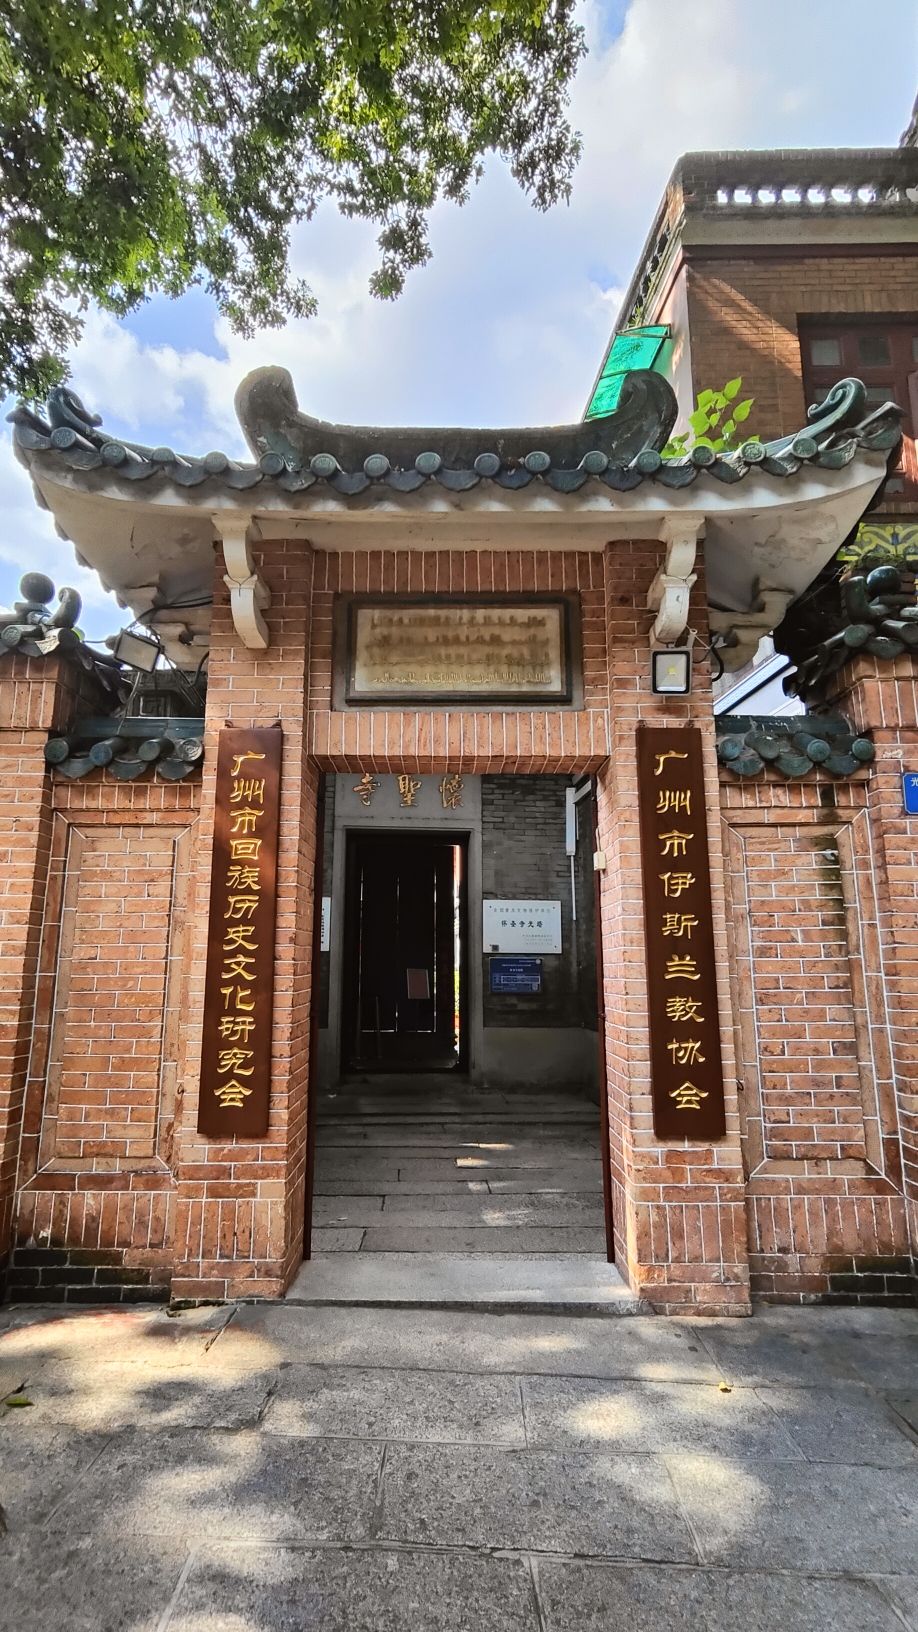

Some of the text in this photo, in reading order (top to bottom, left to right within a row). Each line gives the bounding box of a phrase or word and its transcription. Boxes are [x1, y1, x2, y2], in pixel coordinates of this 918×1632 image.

[214, 751, 267, 1107] 广州市回族历史文化研究会
[654, 750, 709, 1109] 广州市伊斯兰教协会
